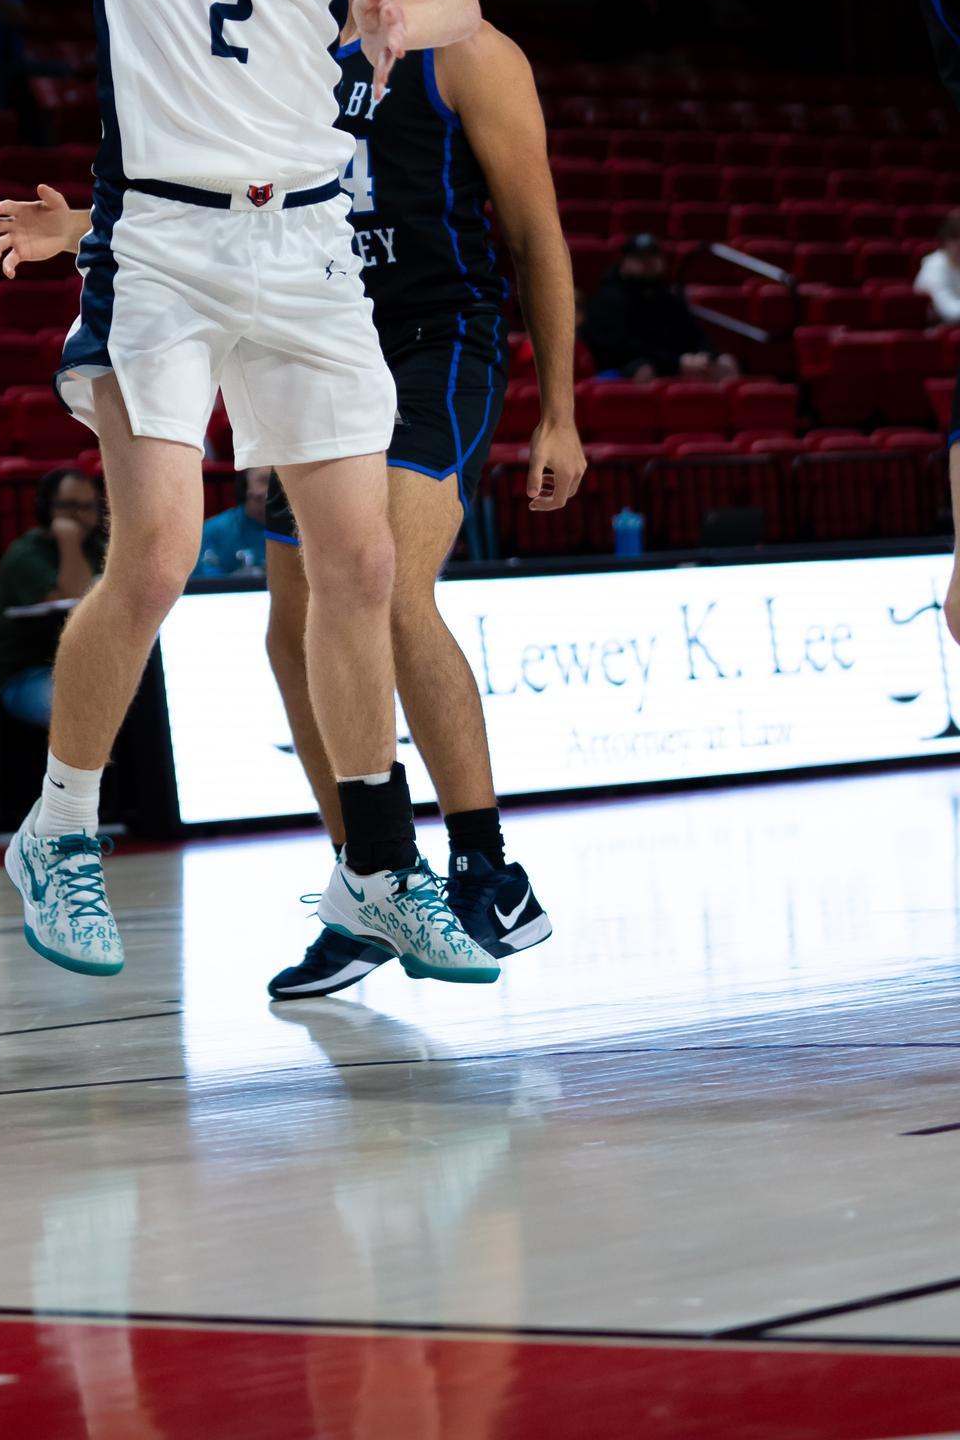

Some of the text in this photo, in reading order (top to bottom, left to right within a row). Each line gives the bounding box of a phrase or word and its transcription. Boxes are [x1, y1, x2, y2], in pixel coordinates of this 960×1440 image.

[341, 80, 392, 121] BY
[476, 594, 858, 715] Lewey K. Lee
